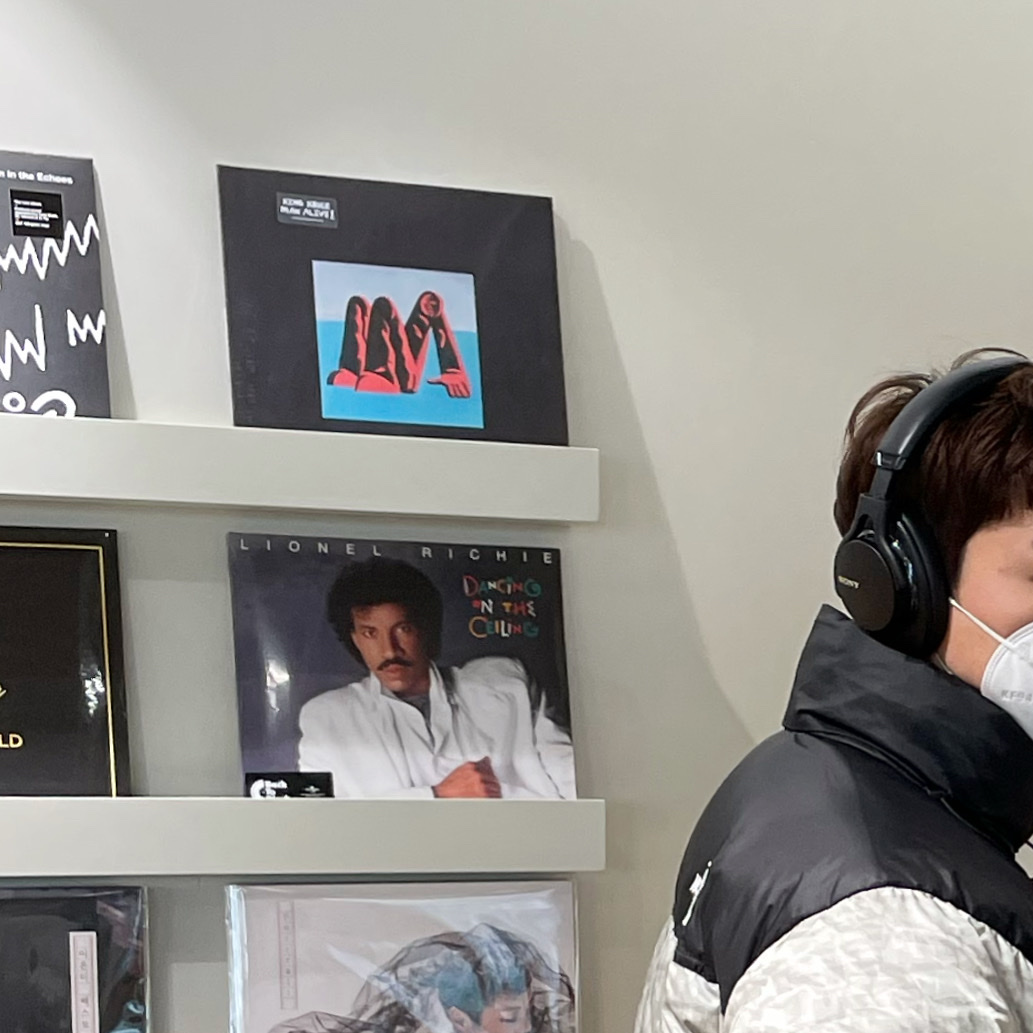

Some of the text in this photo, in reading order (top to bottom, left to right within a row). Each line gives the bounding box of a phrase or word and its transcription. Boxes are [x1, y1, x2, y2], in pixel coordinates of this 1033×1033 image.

[36, 172, 74, 185] Echoes
[240, 538, 552, 564] LIONEL RICHIE
[502, 601, 536, 617] THE
[468, 616, 539, 639] CEILING
